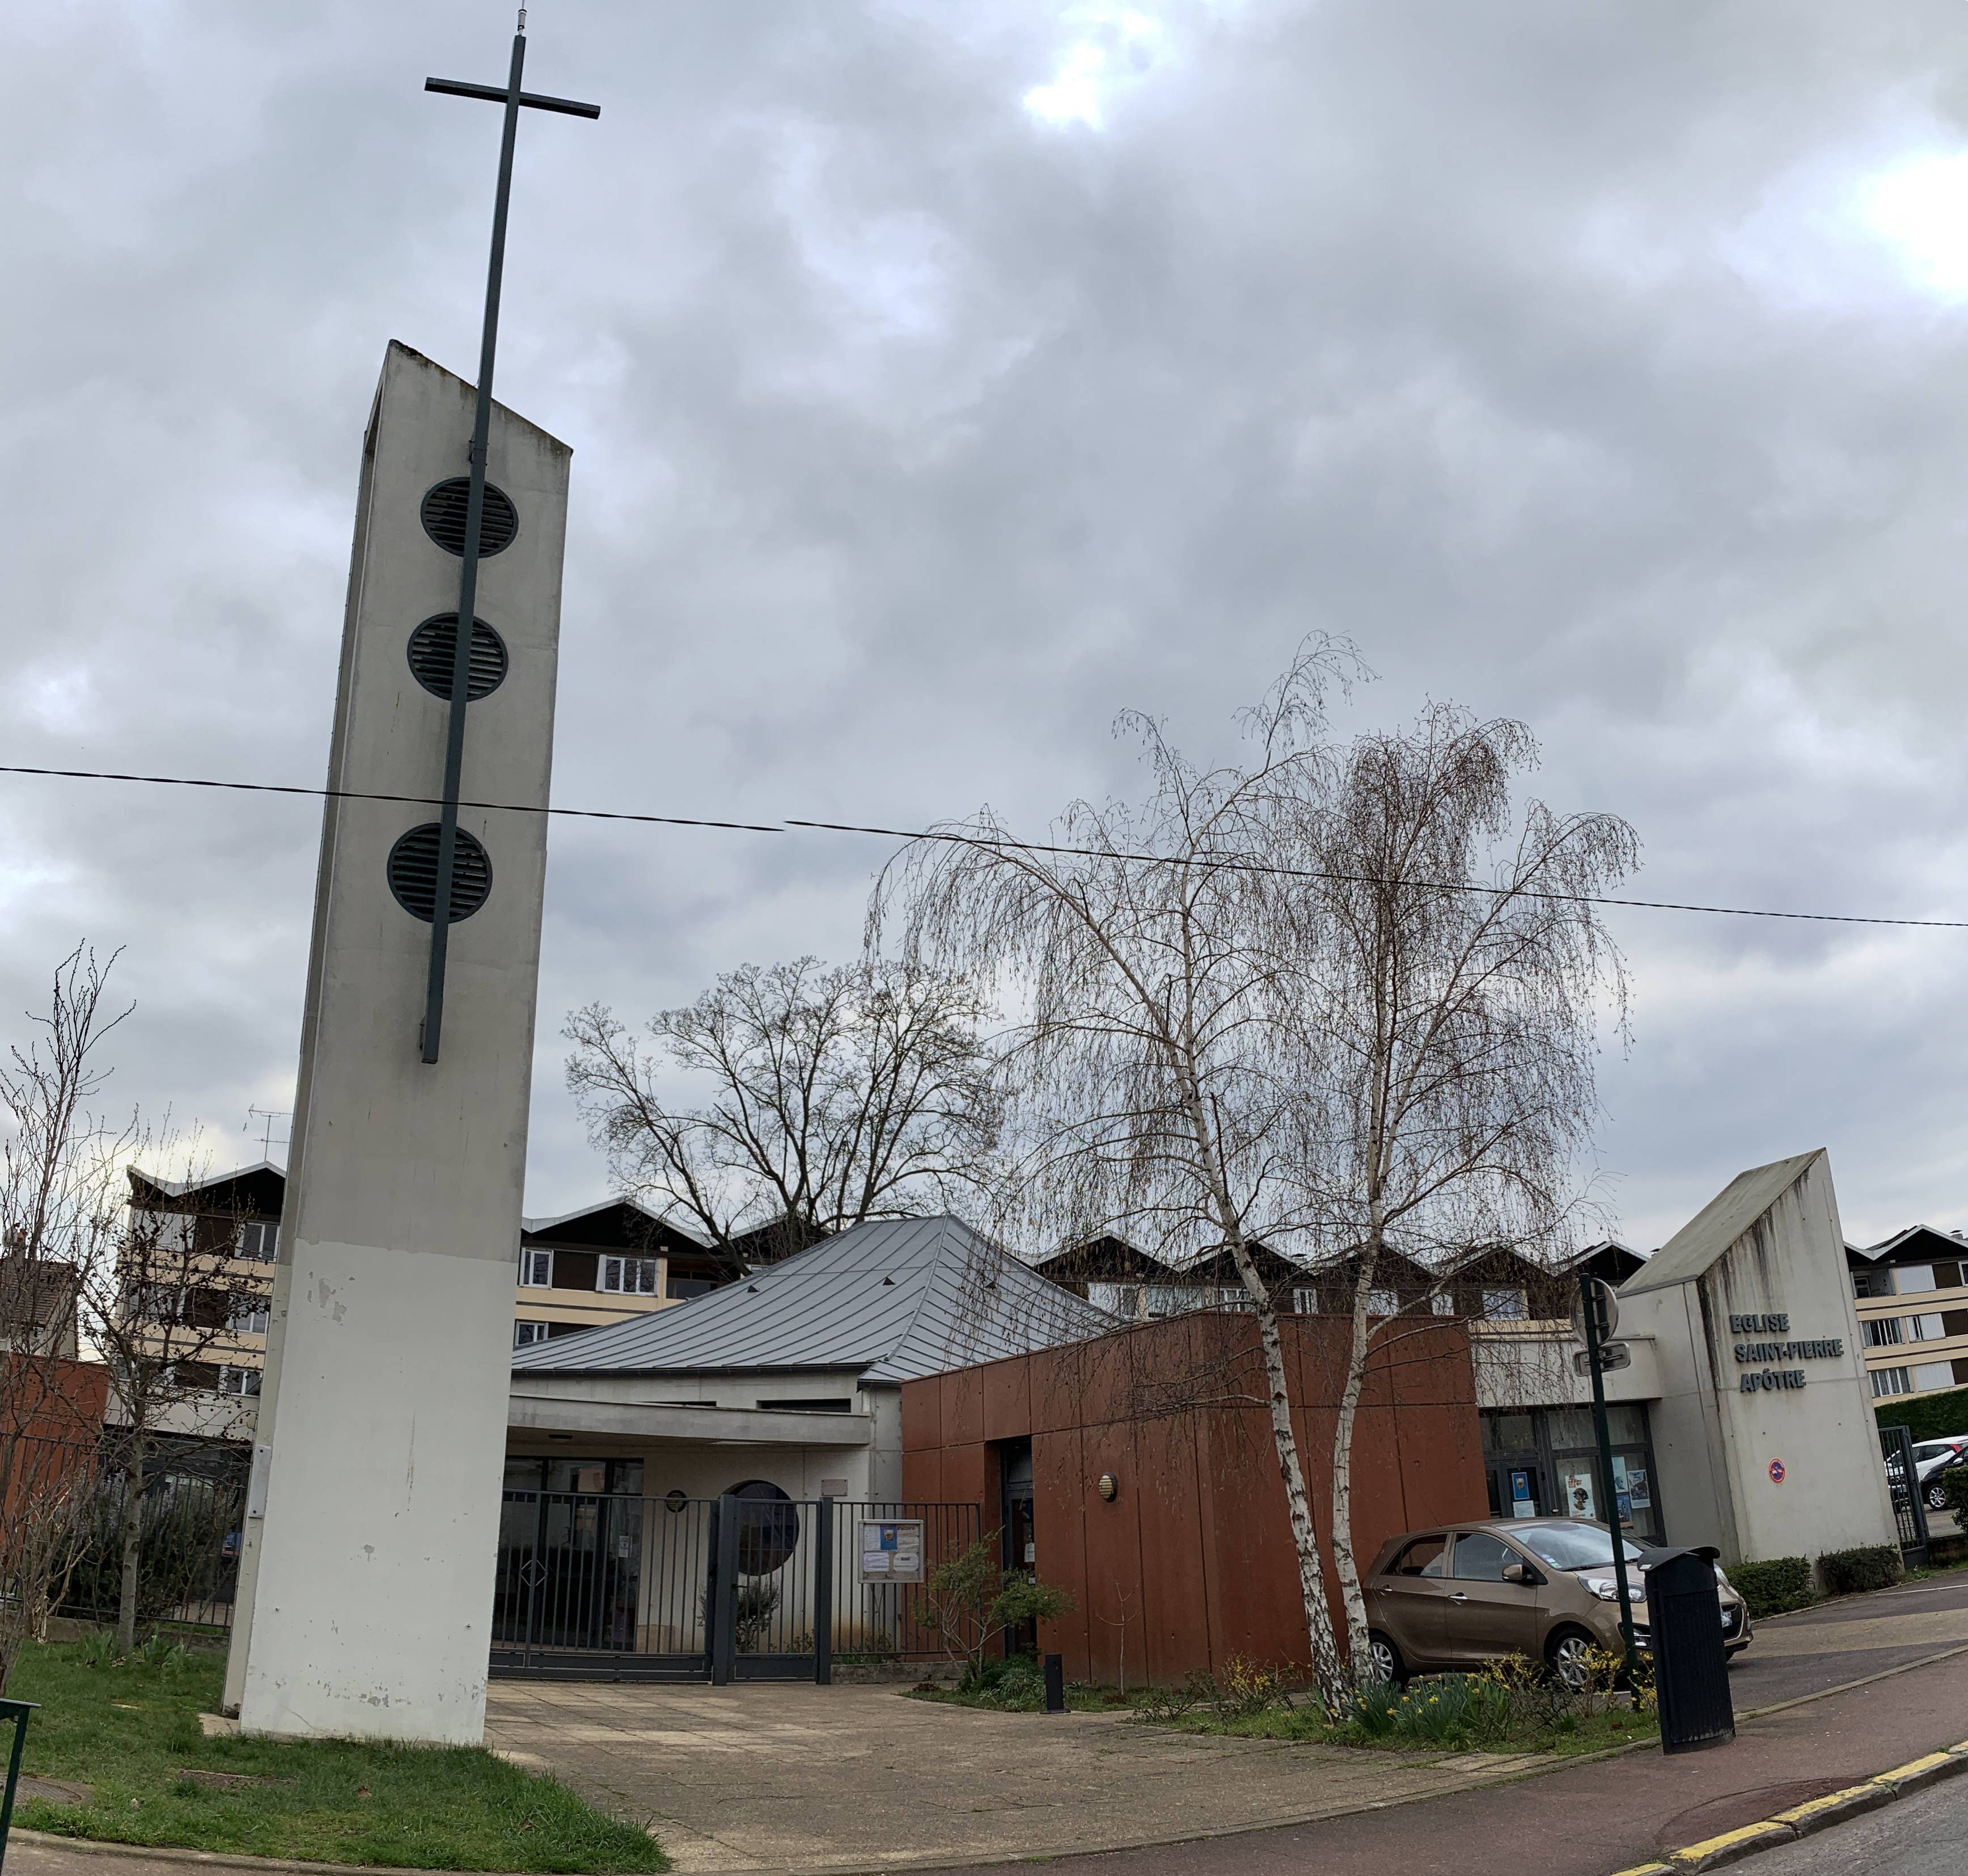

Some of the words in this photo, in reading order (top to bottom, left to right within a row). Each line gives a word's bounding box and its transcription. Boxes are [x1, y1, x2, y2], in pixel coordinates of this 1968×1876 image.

[1729, 1313, 1790, 1333] EGLISE
[1735, 1339, 1844, 1363] SAINT-PIERRE
[1741, 1368, 1806, 1392] APÔTRE
